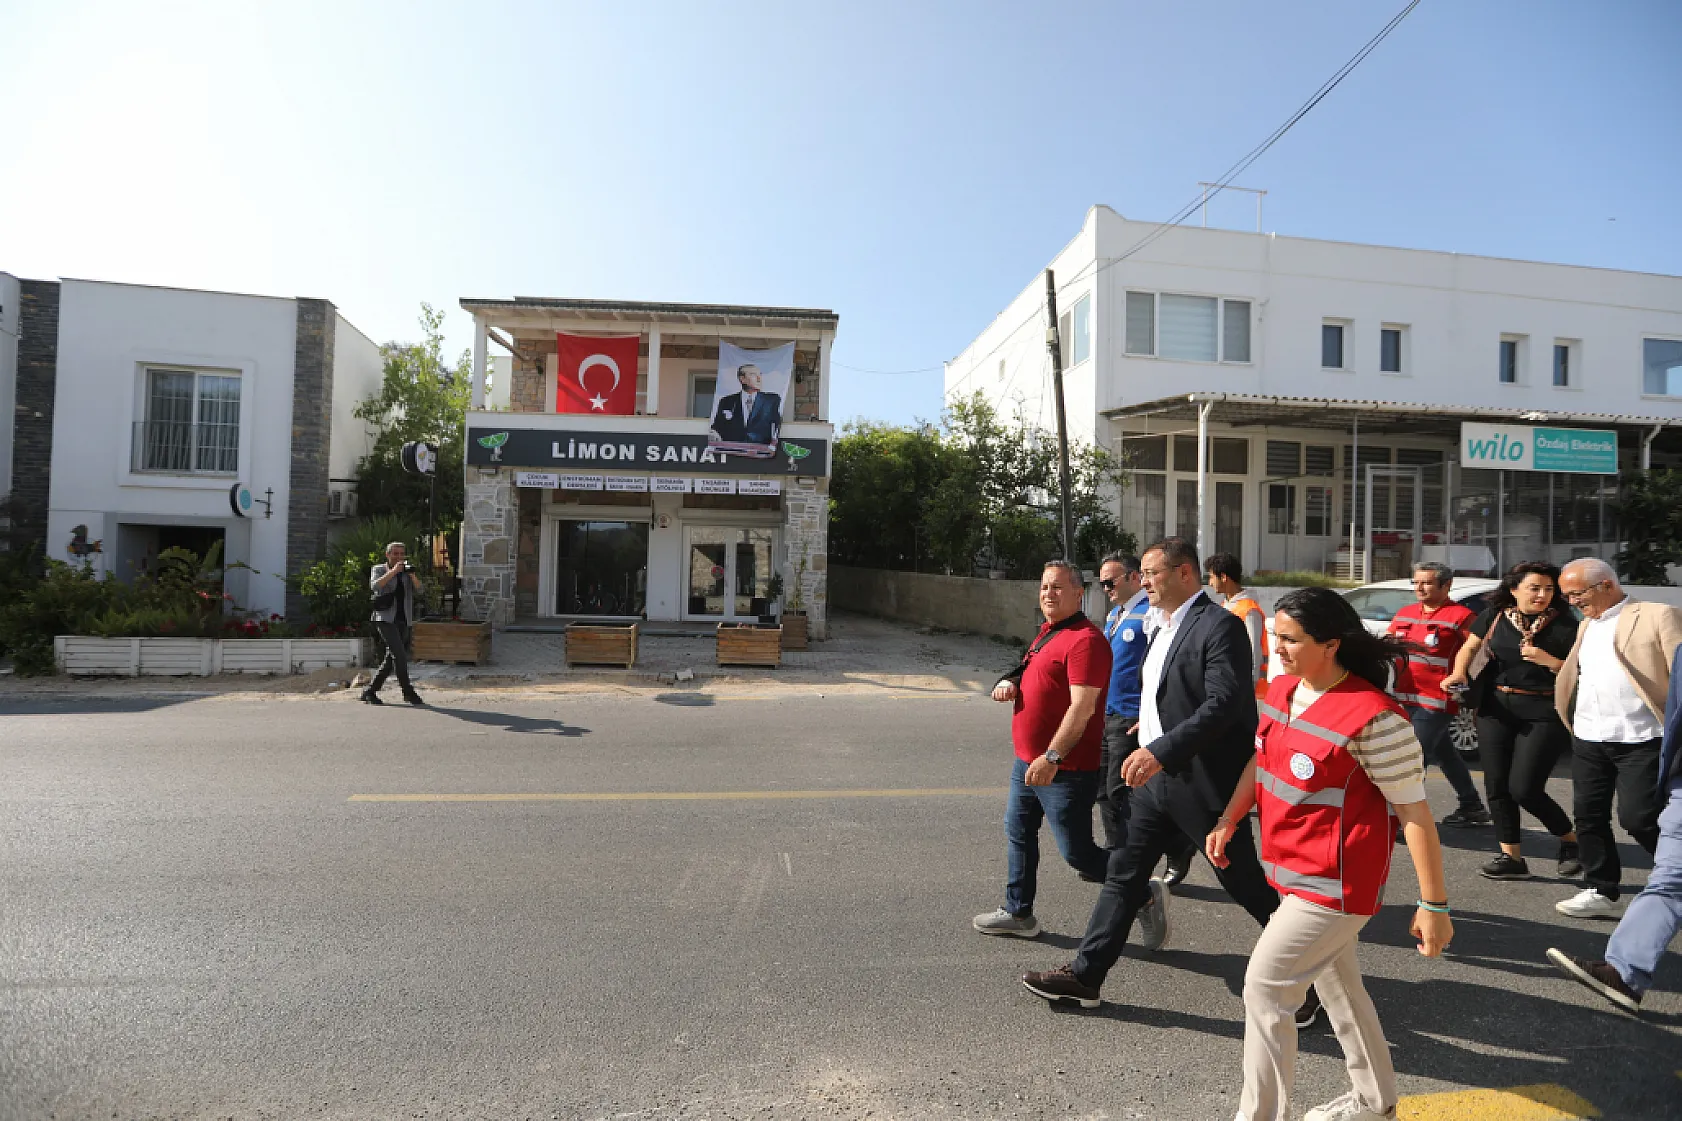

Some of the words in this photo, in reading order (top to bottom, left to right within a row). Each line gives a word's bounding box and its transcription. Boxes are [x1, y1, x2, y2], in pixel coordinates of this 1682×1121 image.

[552, 438, 635, 460] LİMON
[1468, 433, 1524, 461] wilo
[1571, 438, 1613, 451] Elektrik
